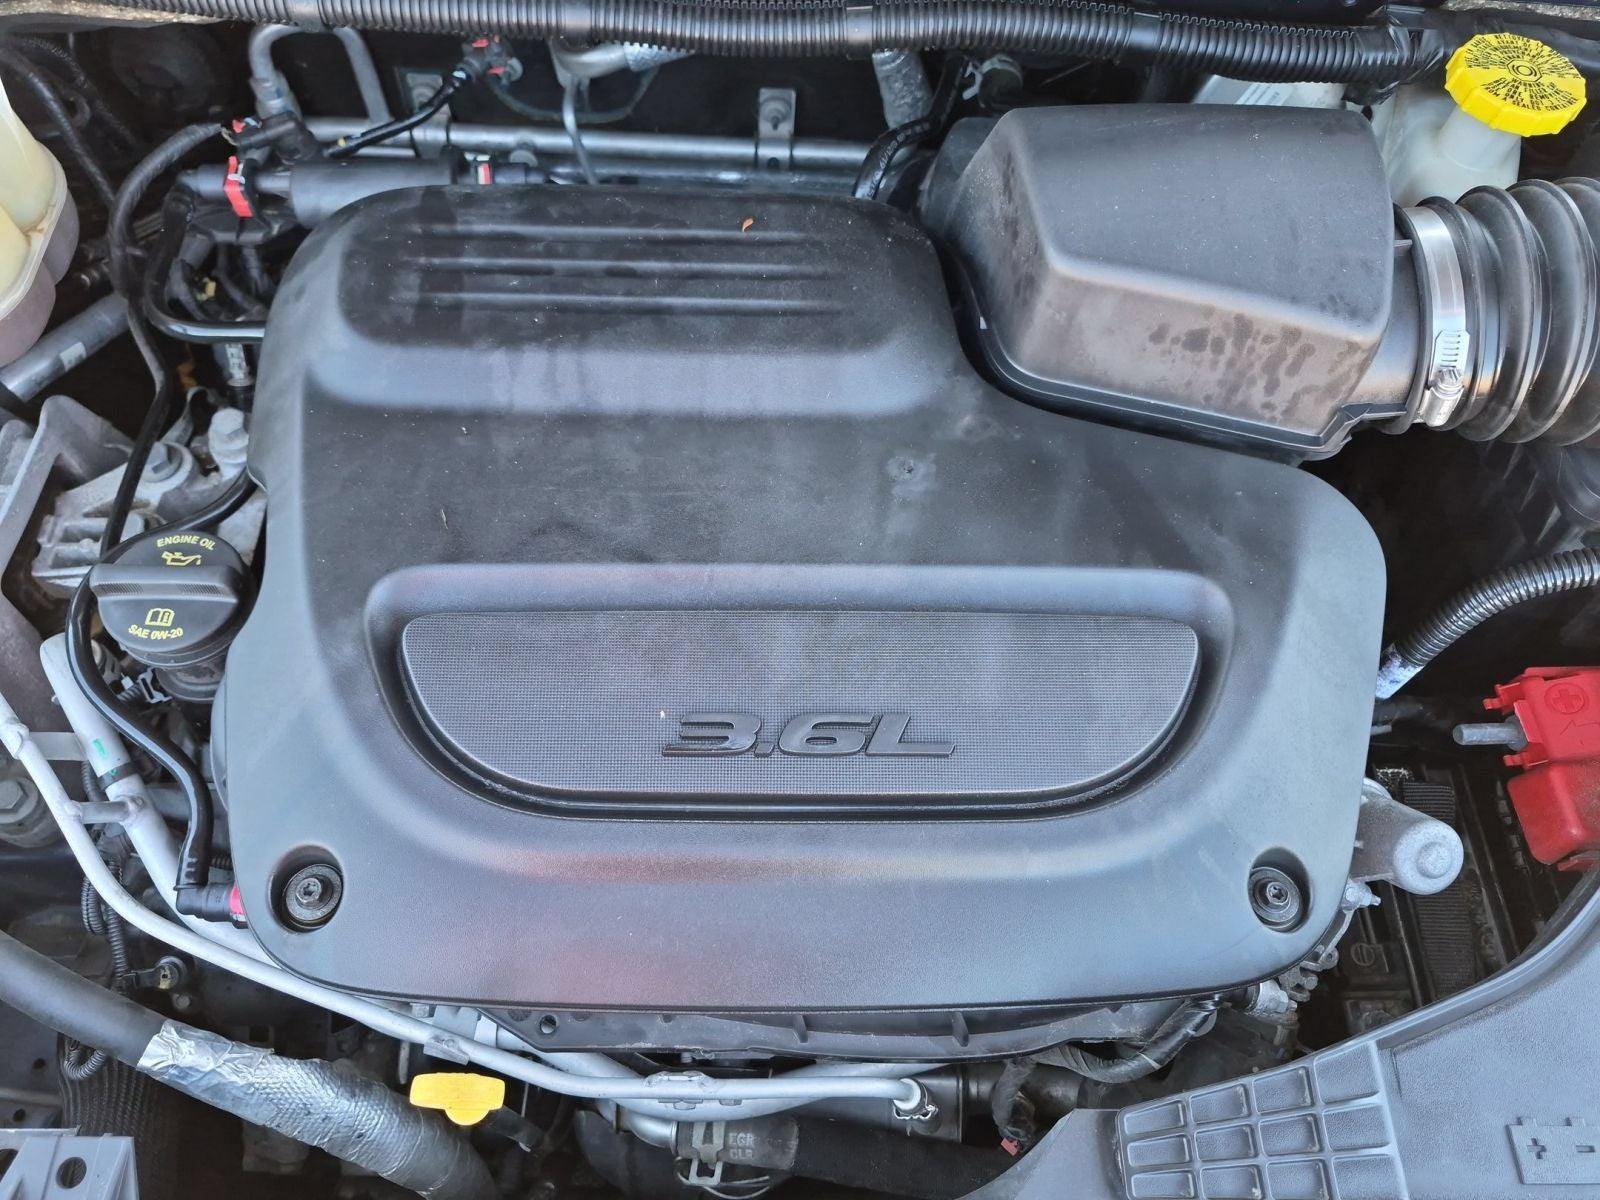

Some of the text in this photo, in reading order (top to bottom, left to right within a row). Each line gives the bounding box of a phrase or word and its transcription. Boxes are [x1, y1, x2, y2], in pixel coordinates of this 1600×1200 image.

[1511, 78, 1544, 87] WARNING
[1530, 89, 1563, 99] REMOVING
[1512, 101, 1541, 111] SEALED
[1545, 98, 1578, 111] CONTAINER
[156, 535, 216, 550] ENGINE OIL
[128, 625, 183, 640] SAE 0W-20
[662, 712, 956, 757] 3.6L
[728, 1133, 755, 1147] EGR
